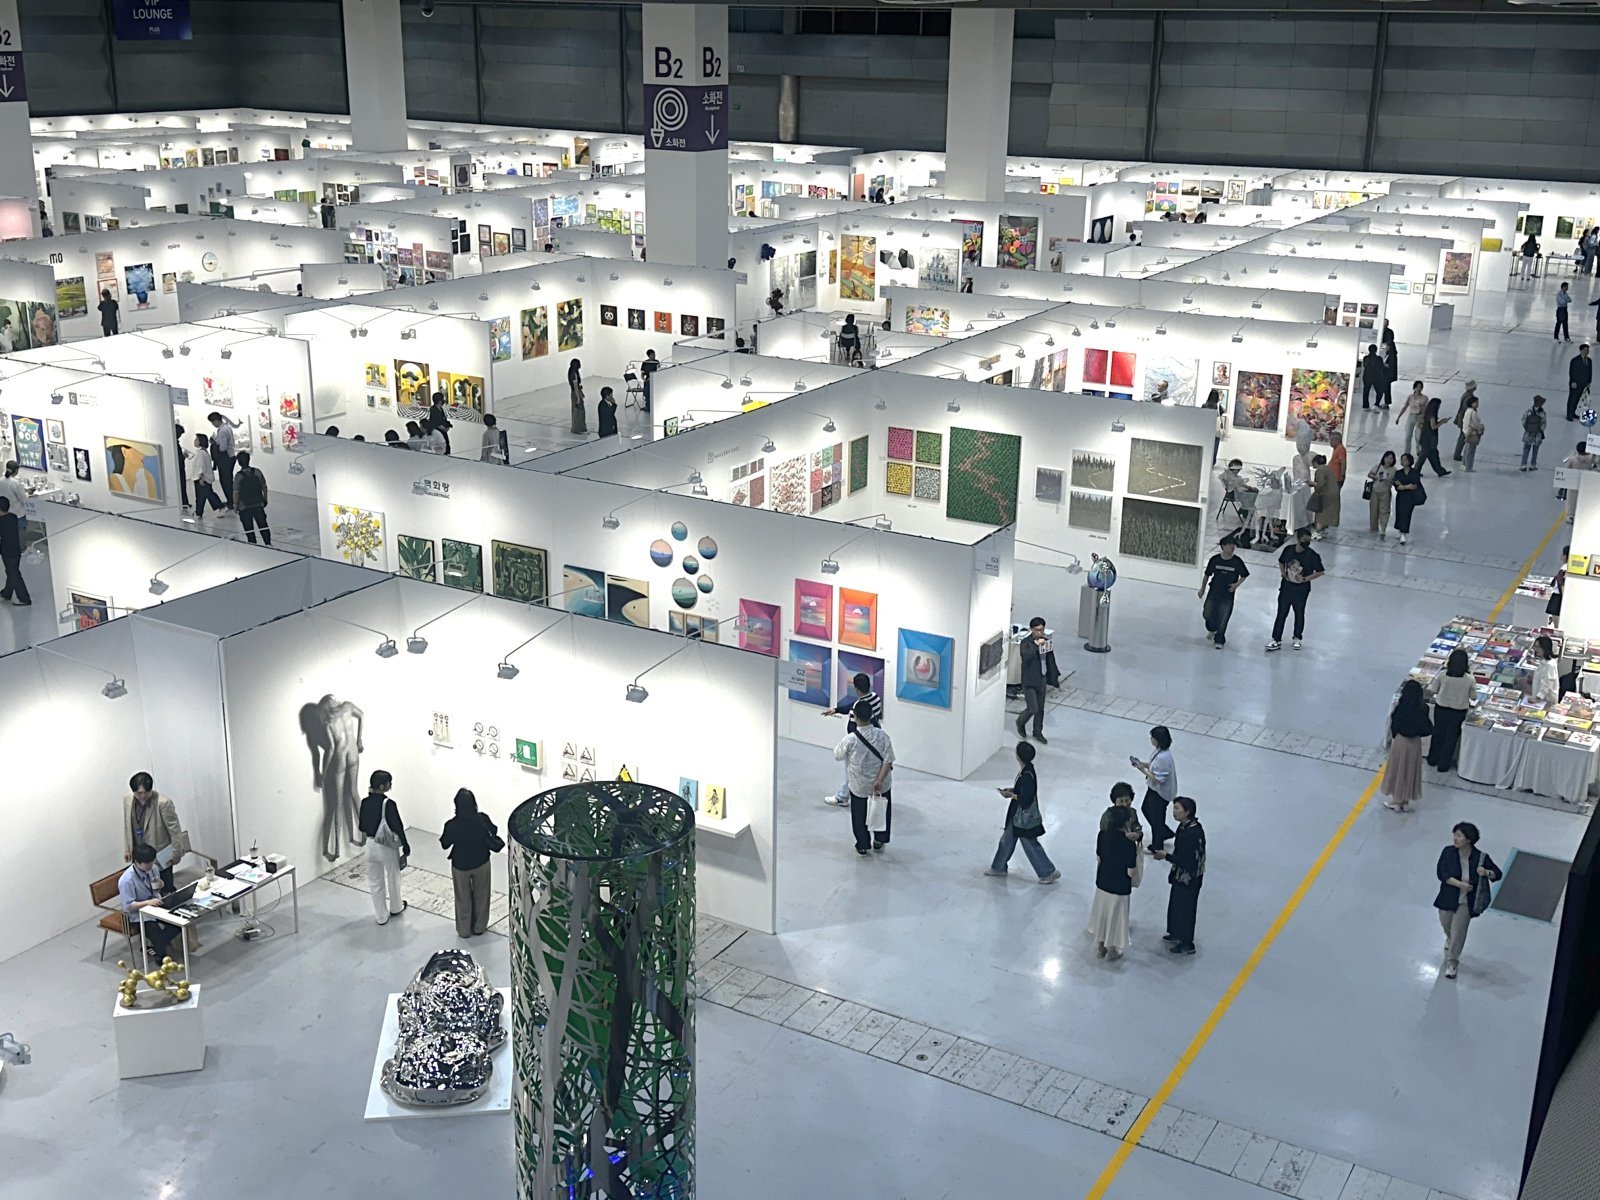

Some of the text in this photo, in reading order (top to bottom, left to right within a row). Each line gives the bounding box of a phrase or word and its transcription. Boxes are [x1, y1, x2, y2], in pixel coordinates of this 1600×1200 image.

[132, 8, 173, 19] LOUNGE
[0, 27, 12, 46] 2
[655, 46, 683, 78] B2
[703, 46, 722, 78] B2
[702, 90, 723, 105] 소화전
[665, 137, 686, 148] 소화전
[423, 479, 450, 493] 맥화랑
[796, 668, 806, 677] G2
